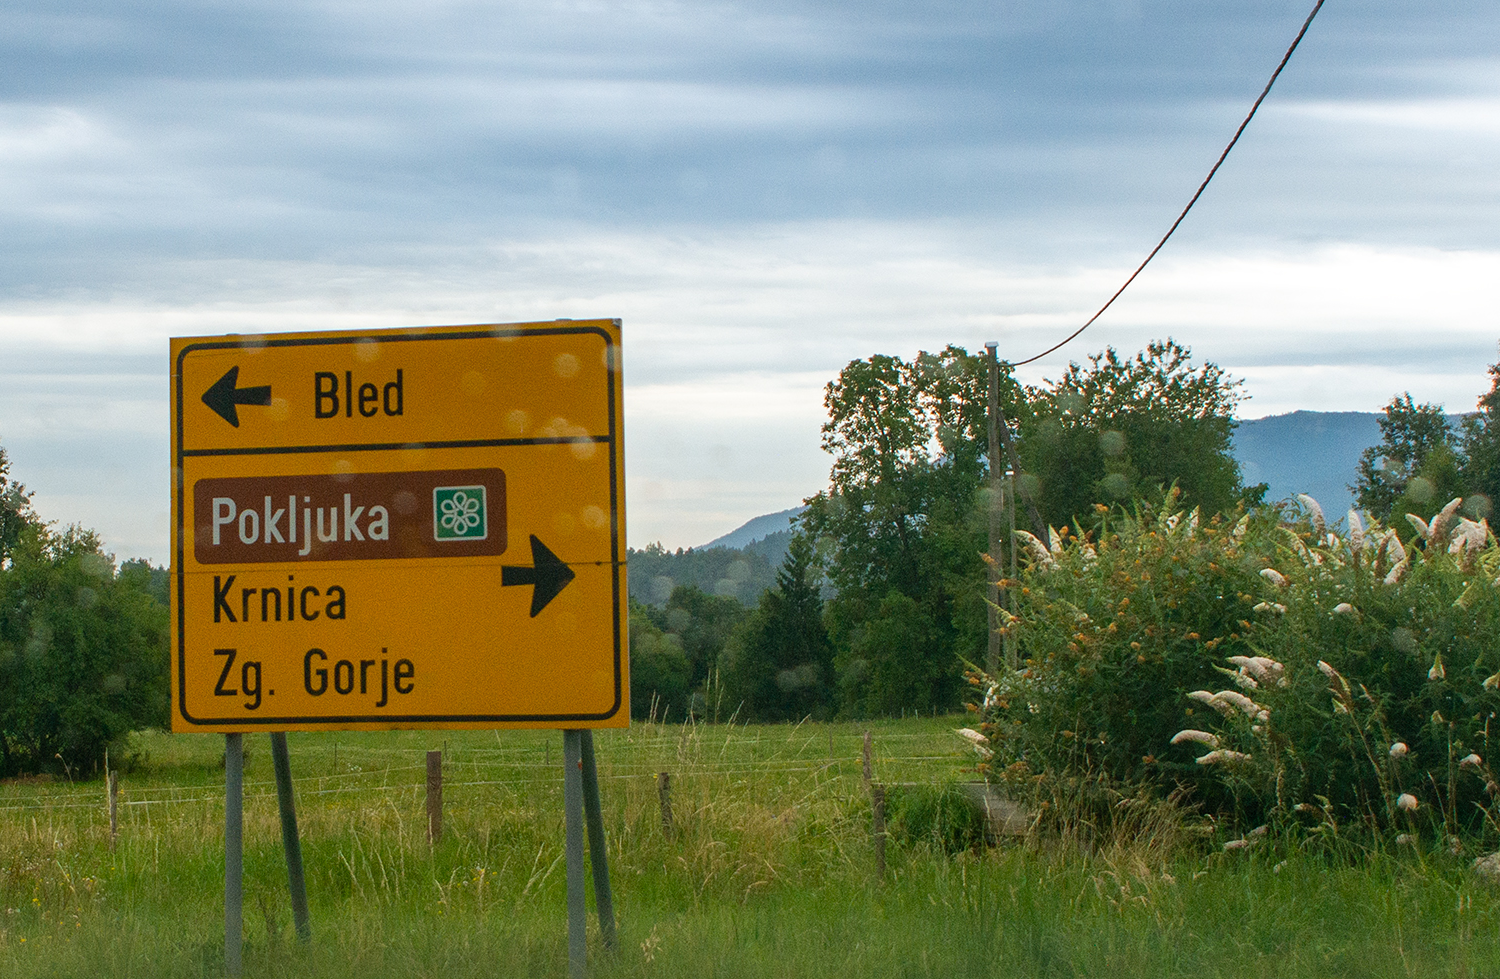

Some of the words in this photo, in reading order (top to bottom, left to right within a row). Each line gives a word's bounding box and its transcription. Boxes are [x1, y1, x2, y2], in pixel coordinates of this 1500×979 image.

[314, 369, 404, 419] Bled
[211, 494, 390, 556] Pokljuka
[212, 575, 347, 623] Krnica
[213, 649, 275, 711] Zg.
[303, 648, 416, 707] Gorje
